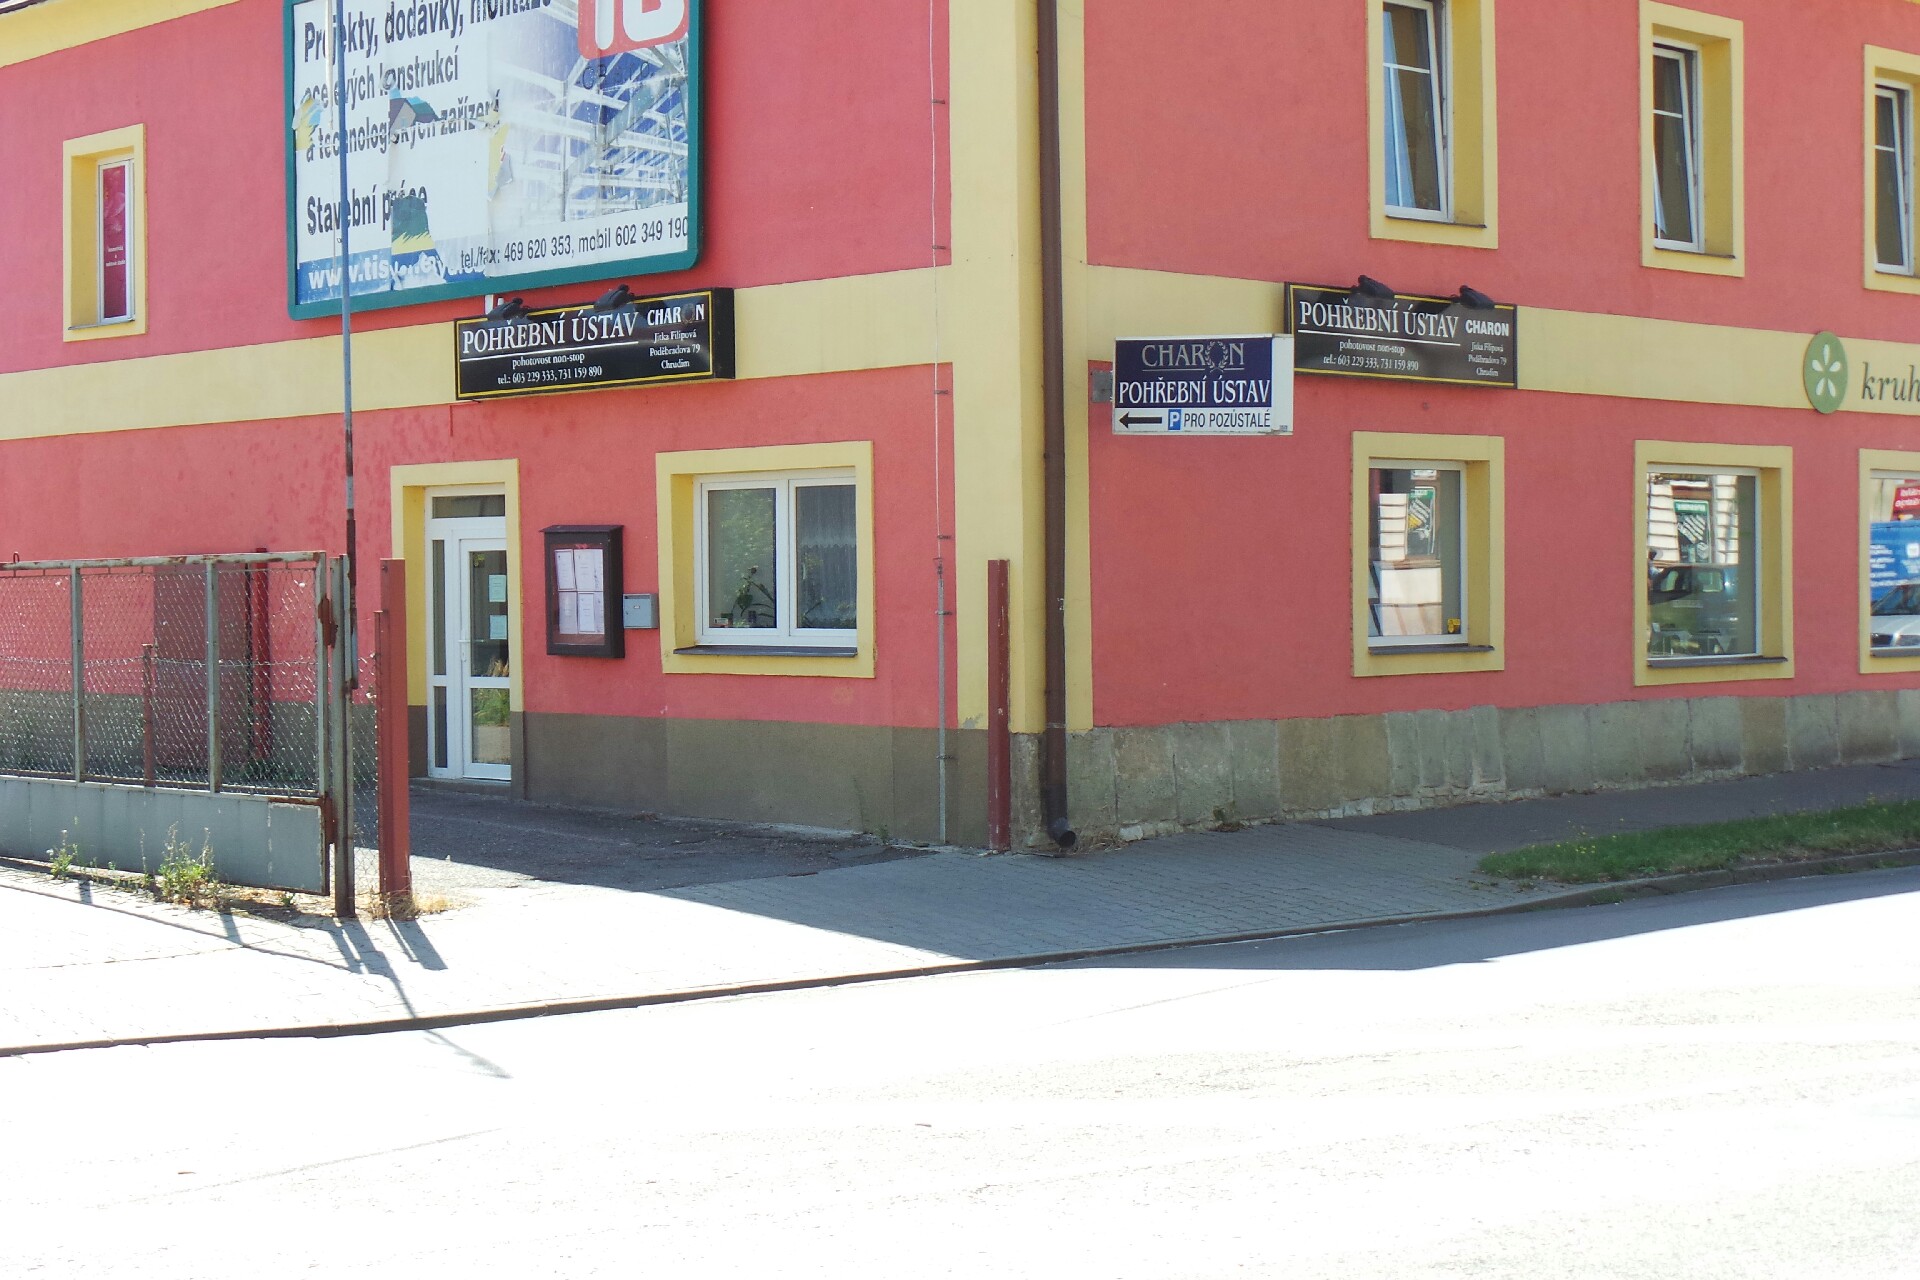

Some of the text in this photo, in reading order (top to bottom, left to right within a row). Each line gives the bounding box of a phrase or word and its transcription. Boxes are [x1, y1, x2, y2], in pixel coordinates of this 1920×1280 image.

[504, 242, 524, 262] 469
[528, 238, 547, 259] 620
[551, 234, 575, 259] 353,
[578, 228, 611, 253] mobil
[615, 224, 637, 247] 602
[641, 220, 663, 243] 349
[1299, 298, 1459, 339] POHŘEBNÍ ÚSTAV
[462, 309, 639, 354] POHŘEBNÍ ÚSTAV
[670, 329, 697, 341] Filipová
[1465, 319, 1509, 337] CHARON
[691, 344, 701, 353] 79
[1142, 341, 1245, 369] CHARON
[1339, 339, 1406, 357] pohotovost non-stop
[512, 353, 585, 370] pohotovost non-stop
[661, 359, 690, 370] Chrudim
[1337, 355, 1351, 367] 603
[1351, 356, 1364, 368] 229
[1365, 357, 1380, 370] 333,
[1380, 358, 1393, 370] 731
[1394, 359, 1406, 371] 159
[1406, 360, 1419, 371] 890
[497, 365, 602, 385] tel.: 603 229 333, 731 159 890
[1119, 375, 1270, 404] POHŘEBNÍ ÚSTAV
[1184, 413, 1205, 428] PRO
